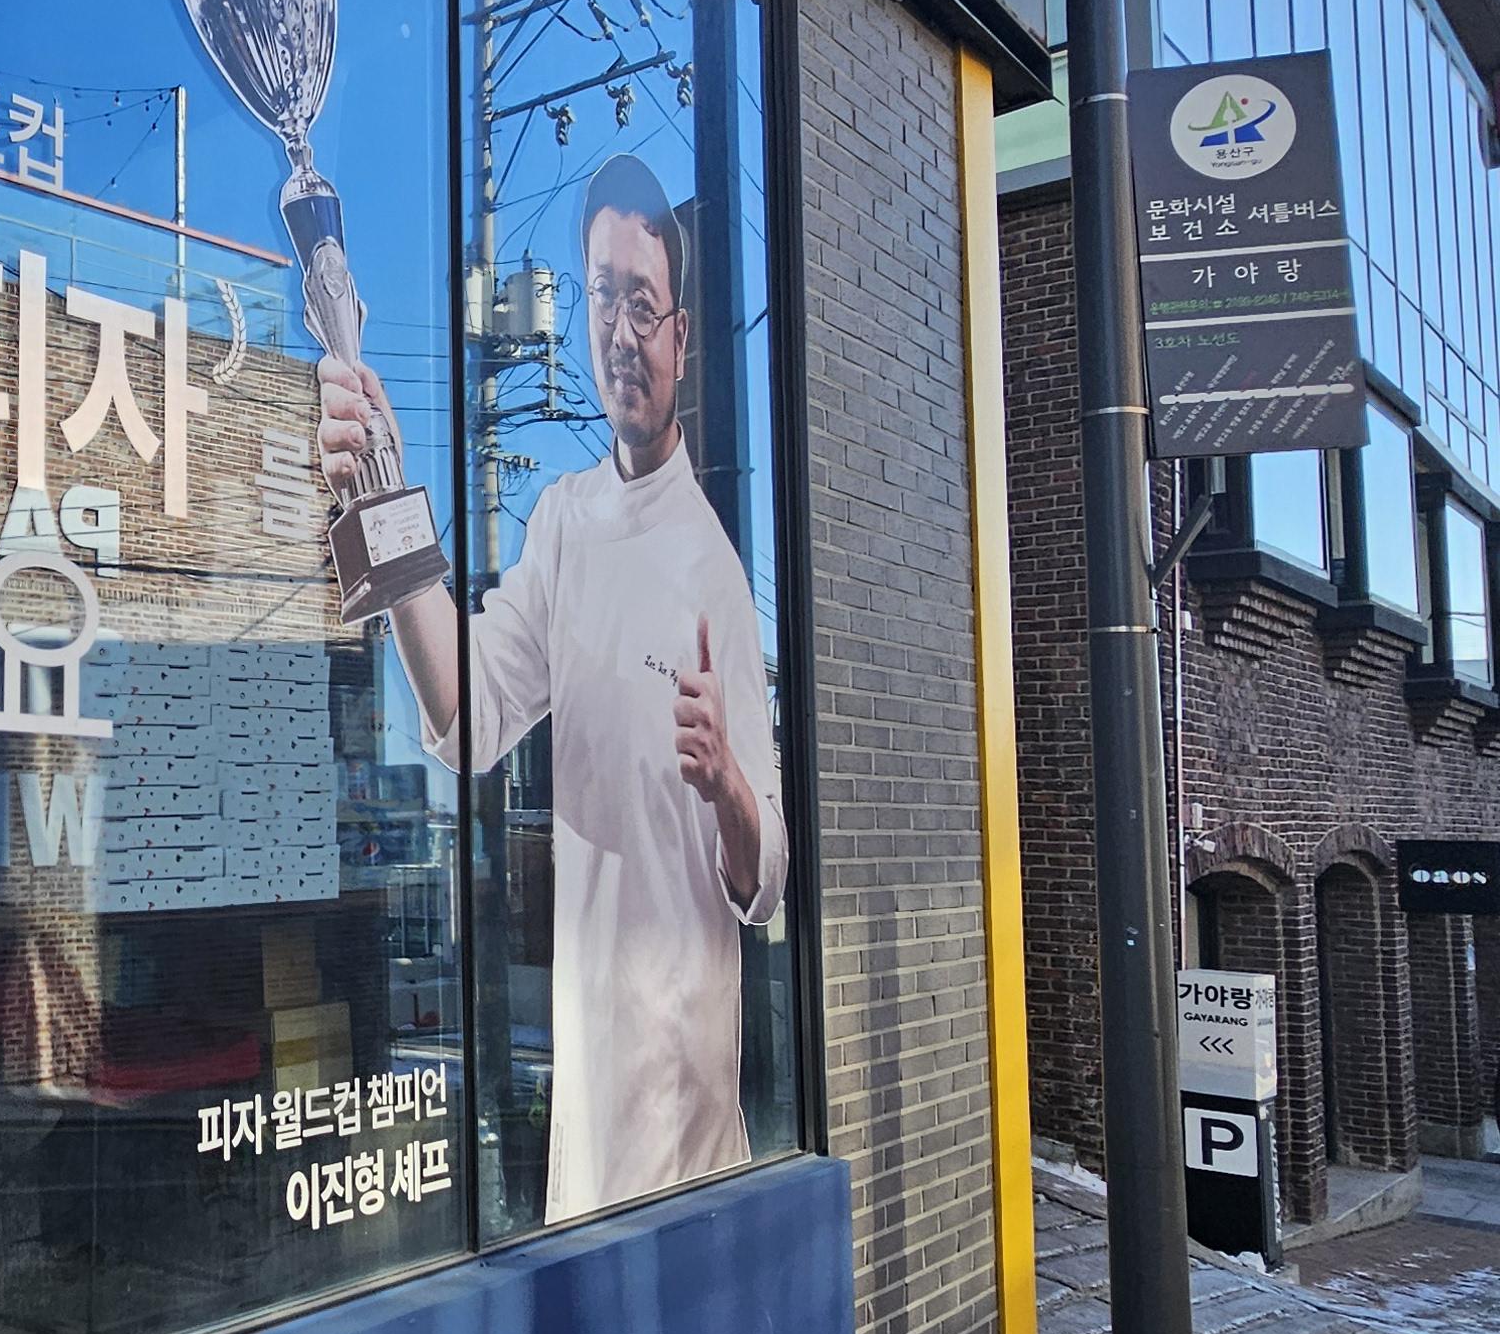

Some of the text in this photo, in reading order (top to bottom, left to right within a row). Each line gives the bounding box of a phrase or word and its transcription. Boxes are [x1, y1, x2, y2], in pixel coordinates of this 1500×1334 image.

[1216, 146, 1255, 160] 용산구
[1146, 193, 1341, 224] 문화시설 셔틀버스
[1179, 983, 1255, 1010] 가야랑
[1183, 1011, 1249, 1027] GAYARANG
[197, 1062, 448, 1161] 피자 월드컵 챔피언
[1200, 1117, 1244, 1166] P
[286, 1138, 453, 1230] 이진형 셰프
